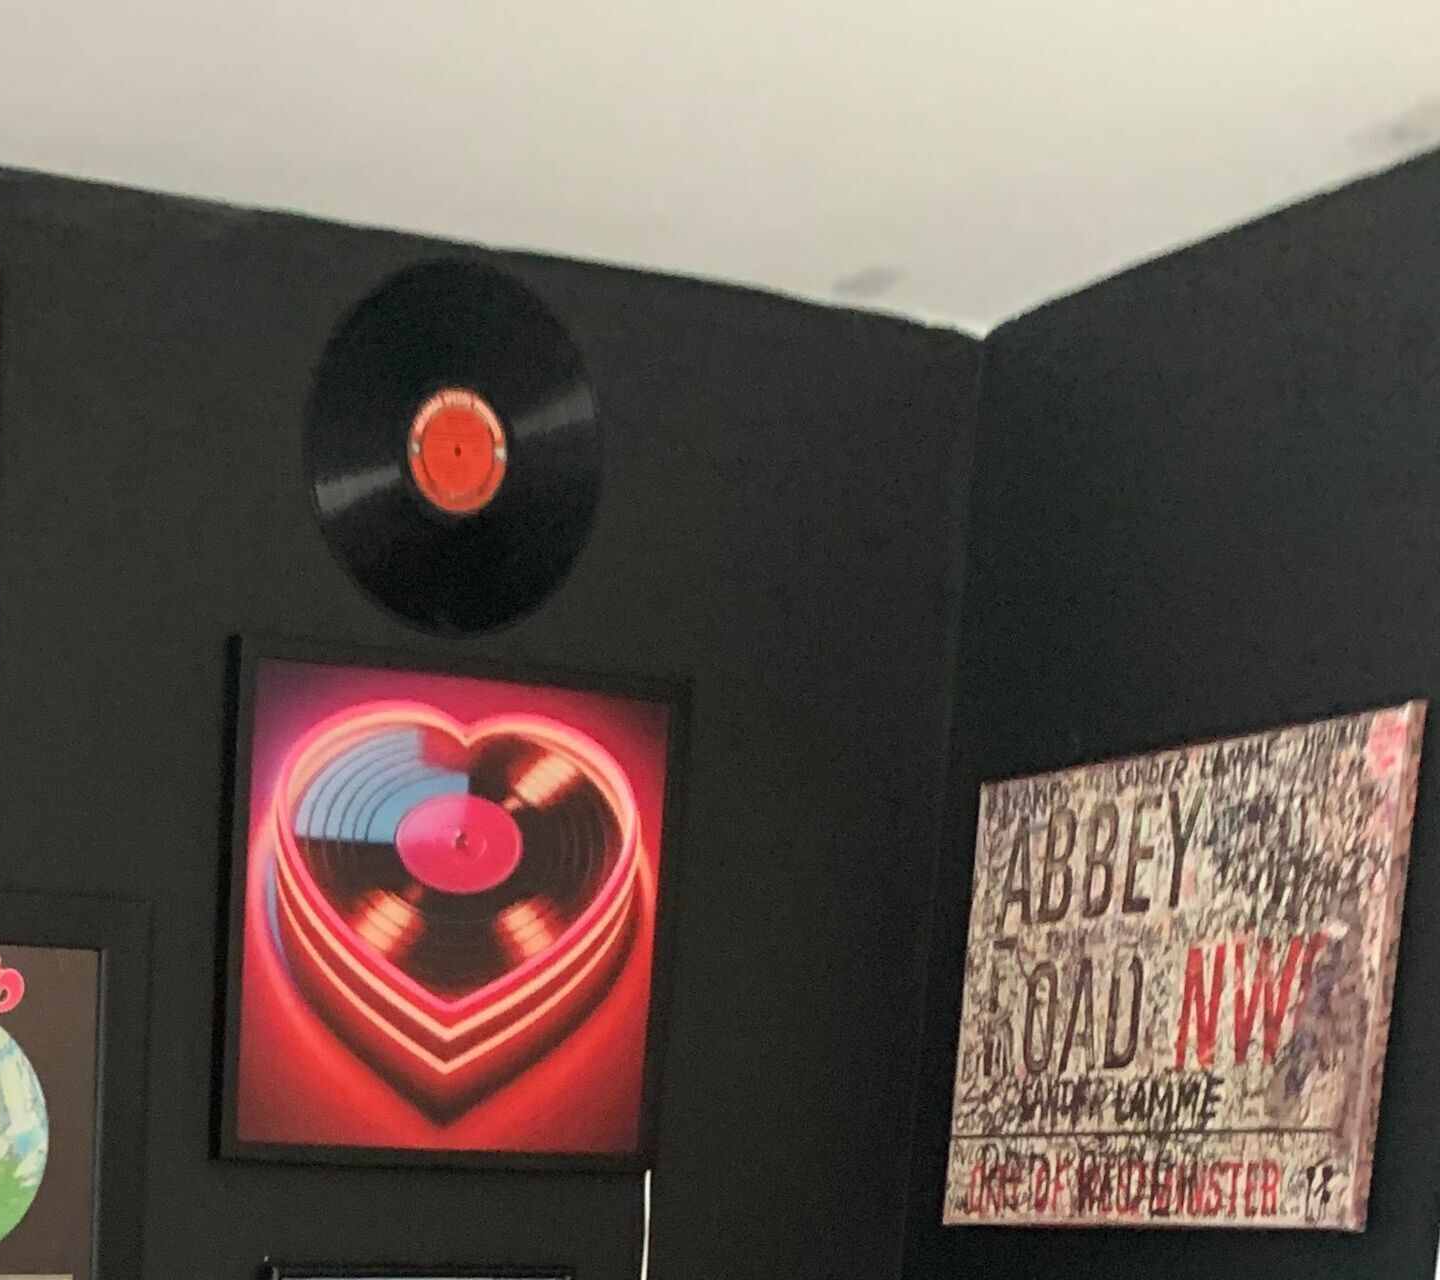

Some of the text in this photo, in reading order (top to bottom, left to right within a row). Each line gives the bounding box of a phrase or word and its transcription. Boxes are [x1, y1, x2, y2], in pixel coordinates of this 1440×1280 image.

[997, 783, 1208, 931] ABBEY
[982, 928, 1329, 1077] ROAD NW
